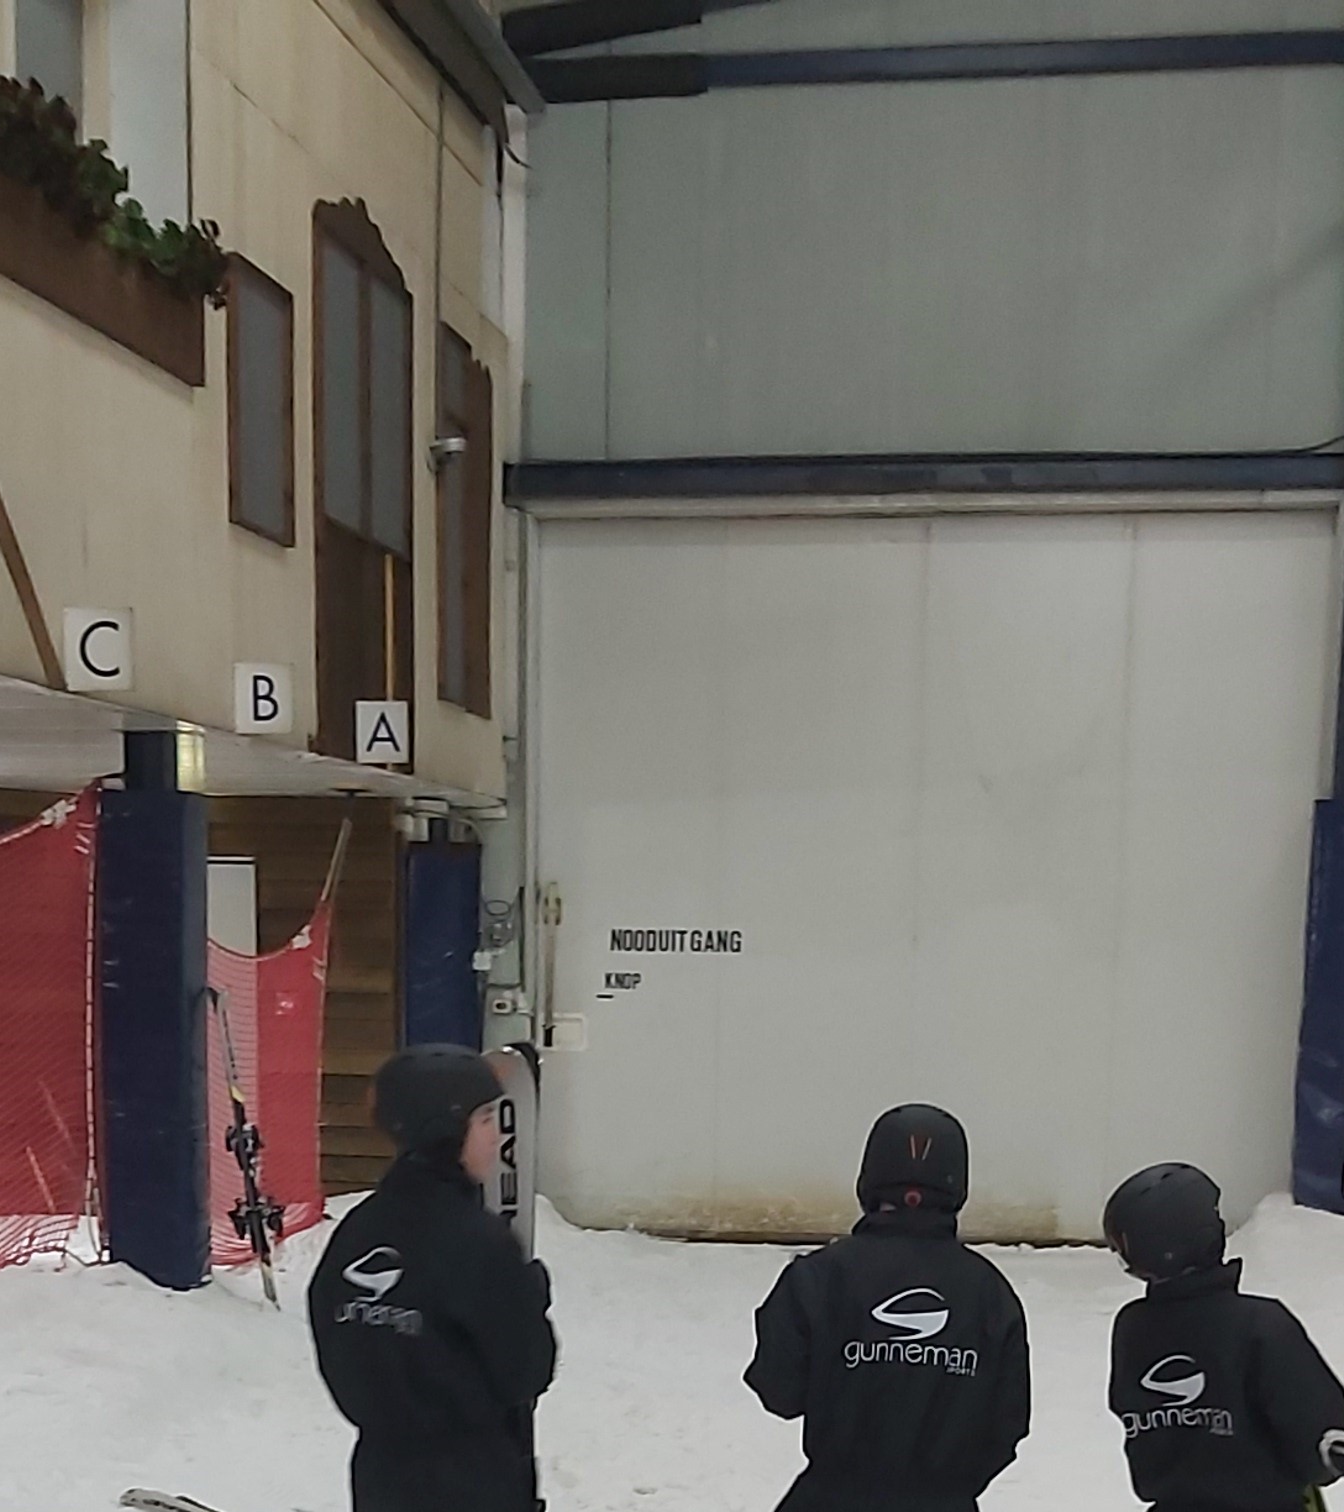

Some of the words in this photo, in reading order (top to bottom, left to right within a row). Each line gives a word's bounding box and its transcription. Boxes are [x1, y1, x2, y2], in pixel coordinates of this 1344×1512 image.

[79, 620, 120, 677] C
[252, 675, 279, 721] B
[366, 712, 400, 752] A
[610, 929, 742, 952] NOODUITGANG
[844, 1341, 978, 1369] gunneman
[1121, 1407, 1232, 1438] gunneman
